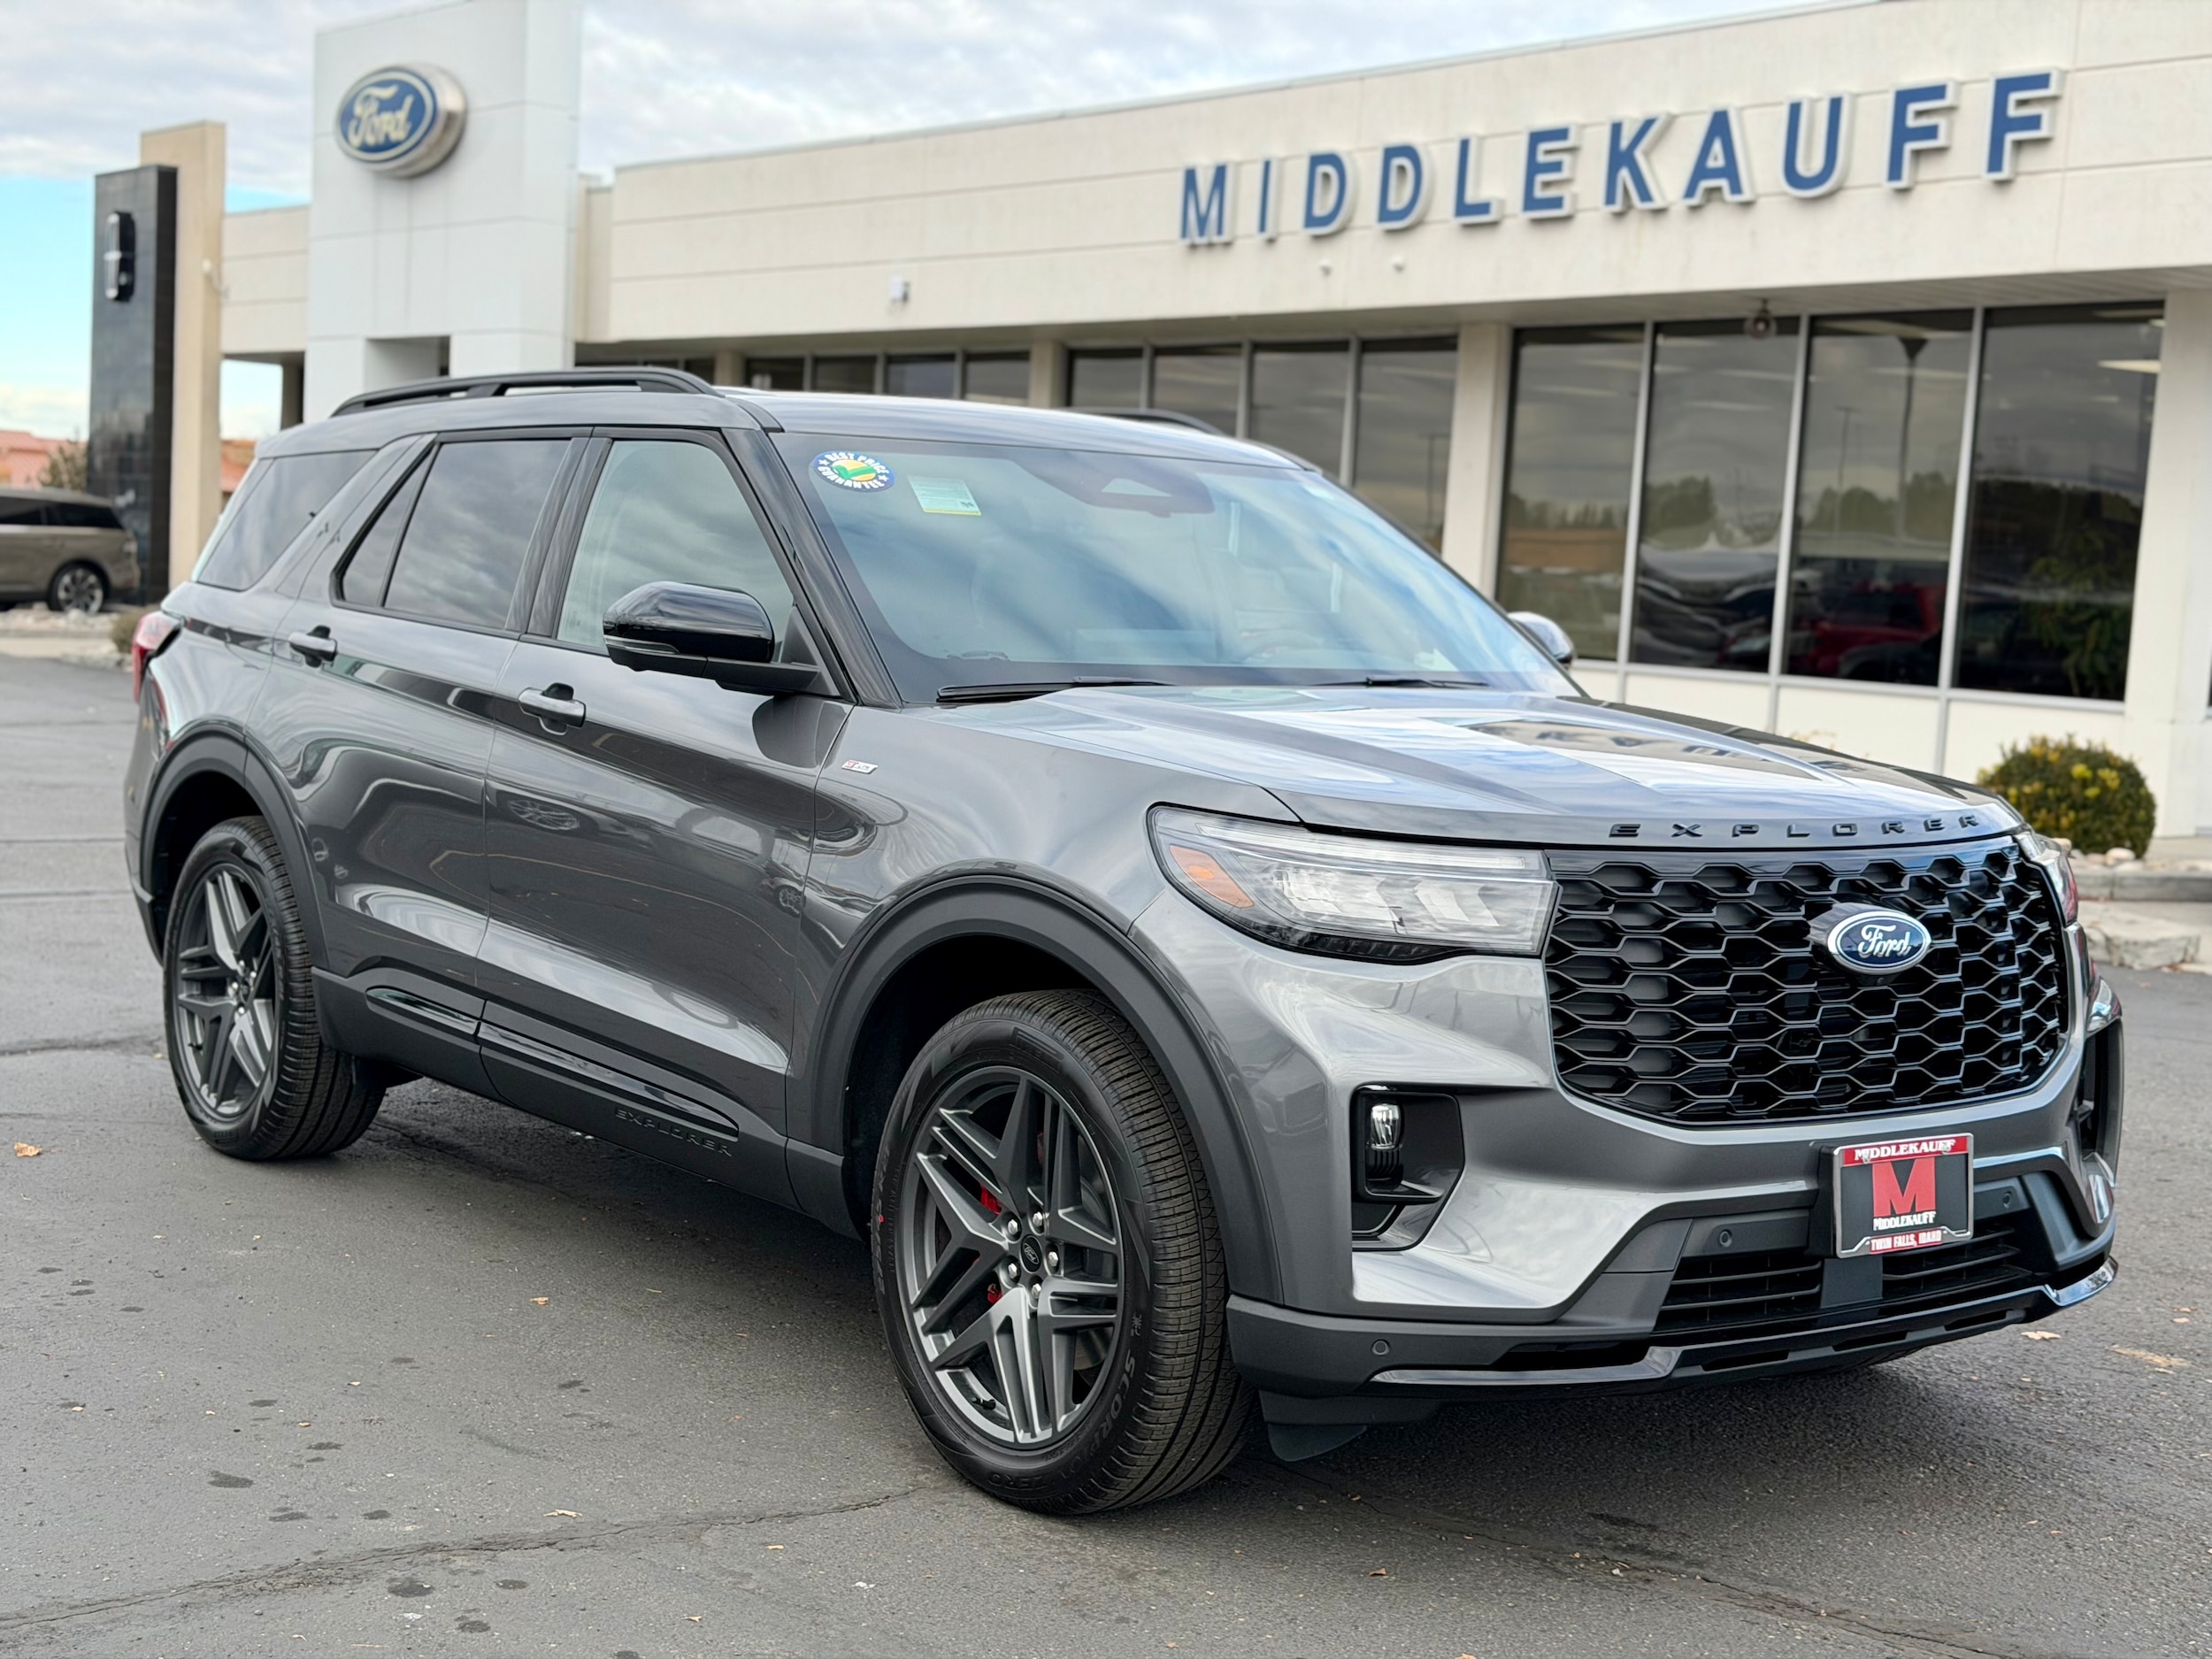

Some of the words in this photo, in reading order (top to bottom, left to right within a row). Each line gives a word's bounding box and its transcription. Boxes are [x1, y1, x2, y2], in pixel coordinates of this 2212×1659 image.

[348, 84, 415, 150] Ford
[1180, 69, 2060, 245] MIDDLEKAUFF
[817, 465, 886, 490] GUARANTEE
[824, 450, 856, 462] BEST
[856, 454, 890, 476] PRICE
[1609, 814, 1980, 839] EXPLORER
[1857, 924, 1912, 958] Ford
[616, 1109, 732, 1156] EXPLORER
[1872, 1157, 1936, 1217] M
[1873, 1211, 1936, 1231] MIDDLEKAUFF
[1870, 1236, 1893, 1252] TWIN
[1893, 1233, 1918, 1248] FALLS,
[1918, 1229, 1942, 1245] IDAHO
